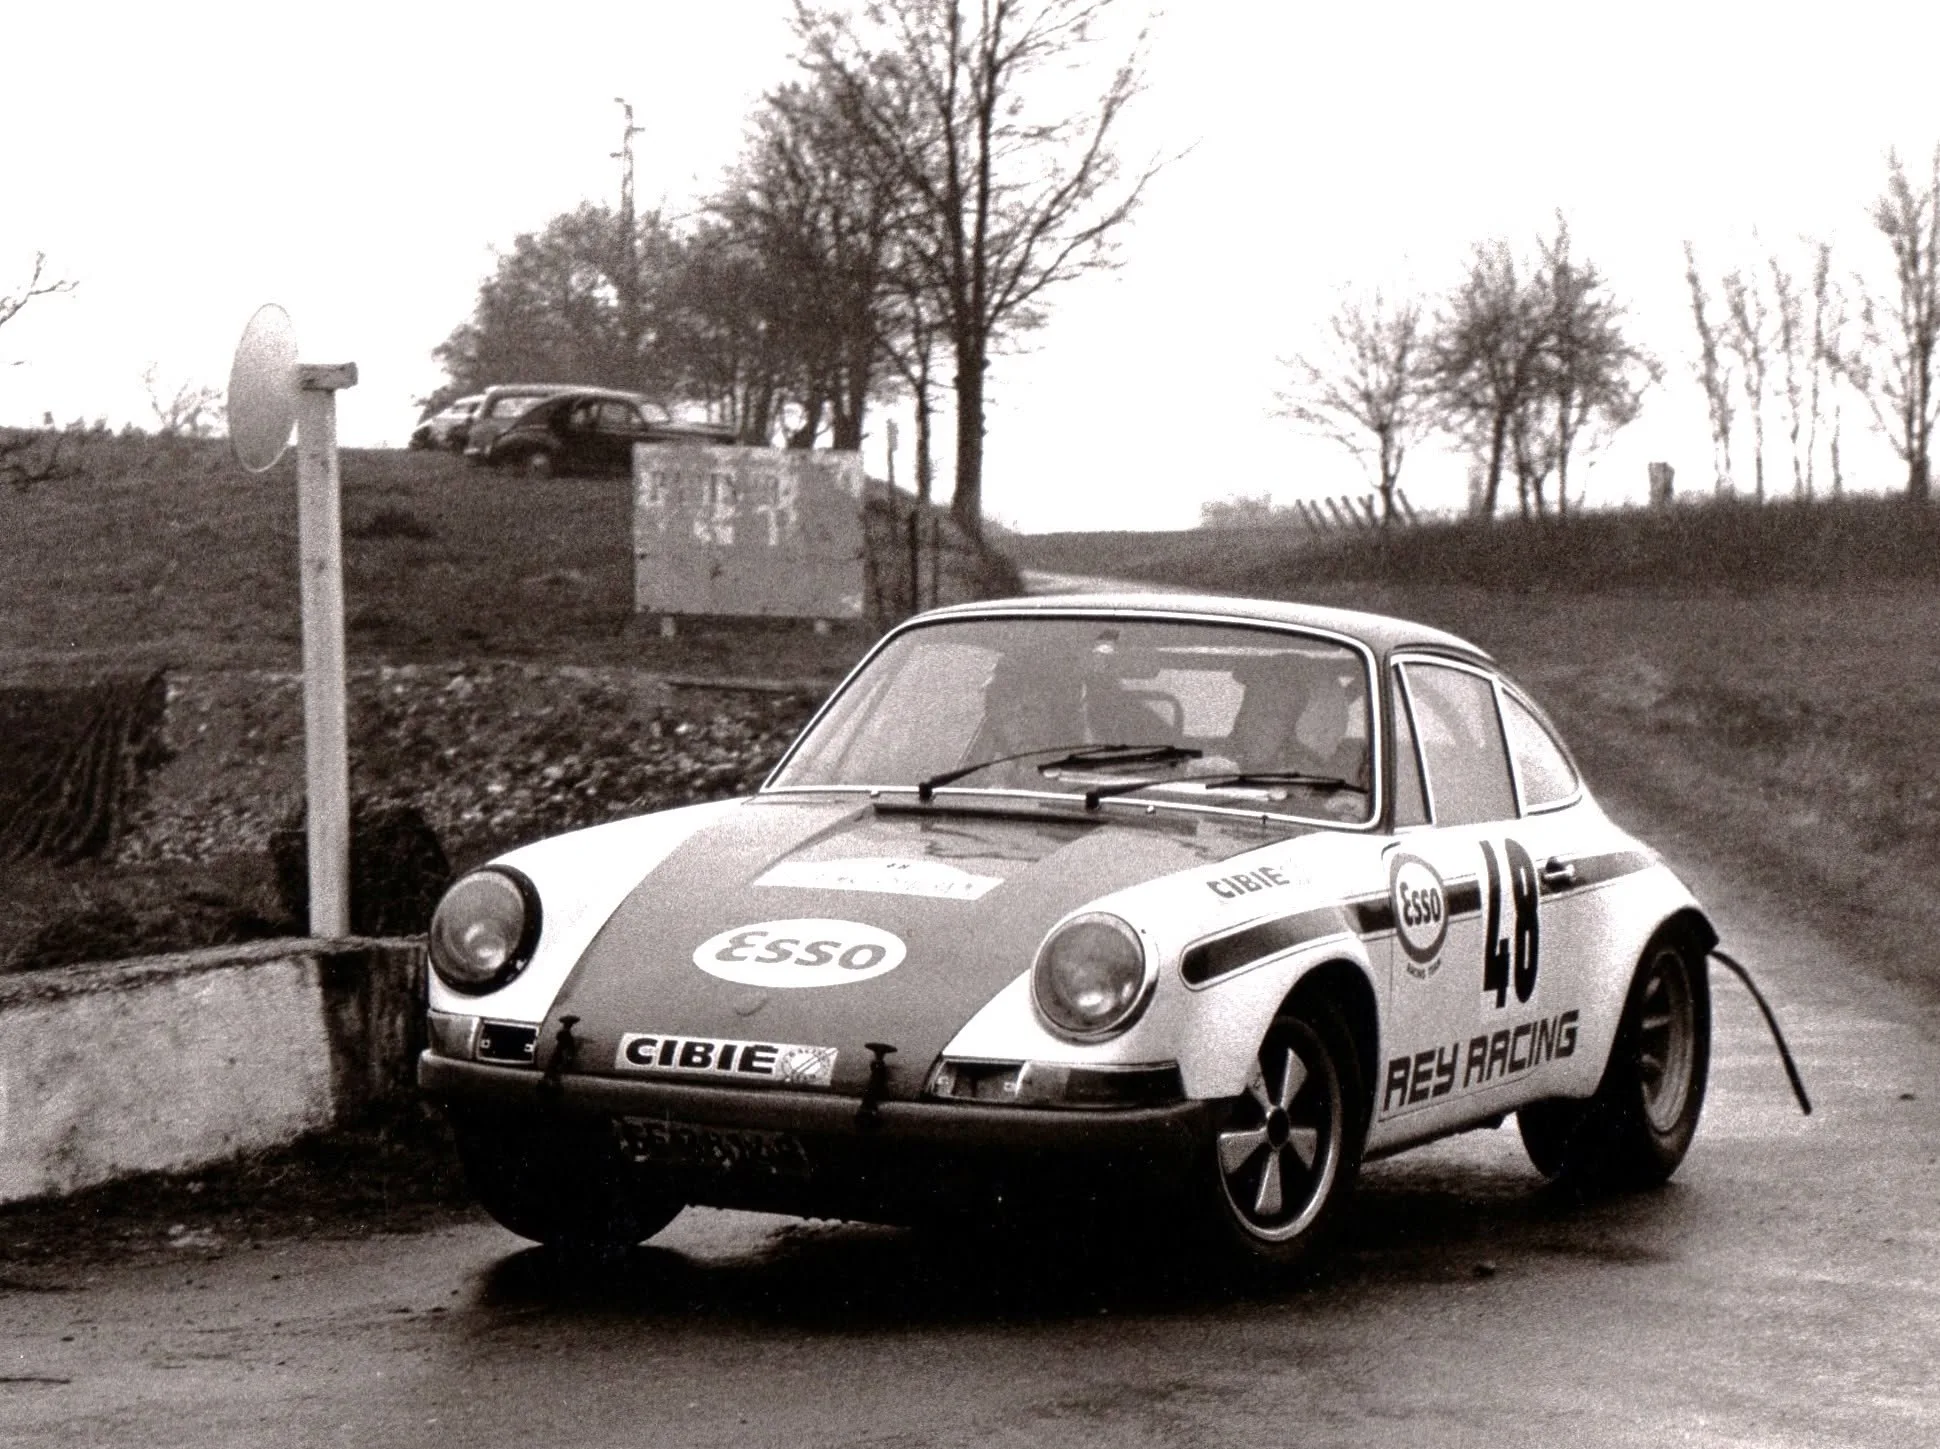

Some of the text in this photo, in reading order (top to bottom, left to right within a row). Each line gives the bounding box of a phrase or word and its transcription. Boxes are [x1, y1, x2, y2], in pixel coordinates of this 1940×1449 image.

[1206, 866, 1290, 898] CIBIE
[1479, 838, 1539, 1008] 48
[1384, 1009, 1580, 1112] REY RACING
